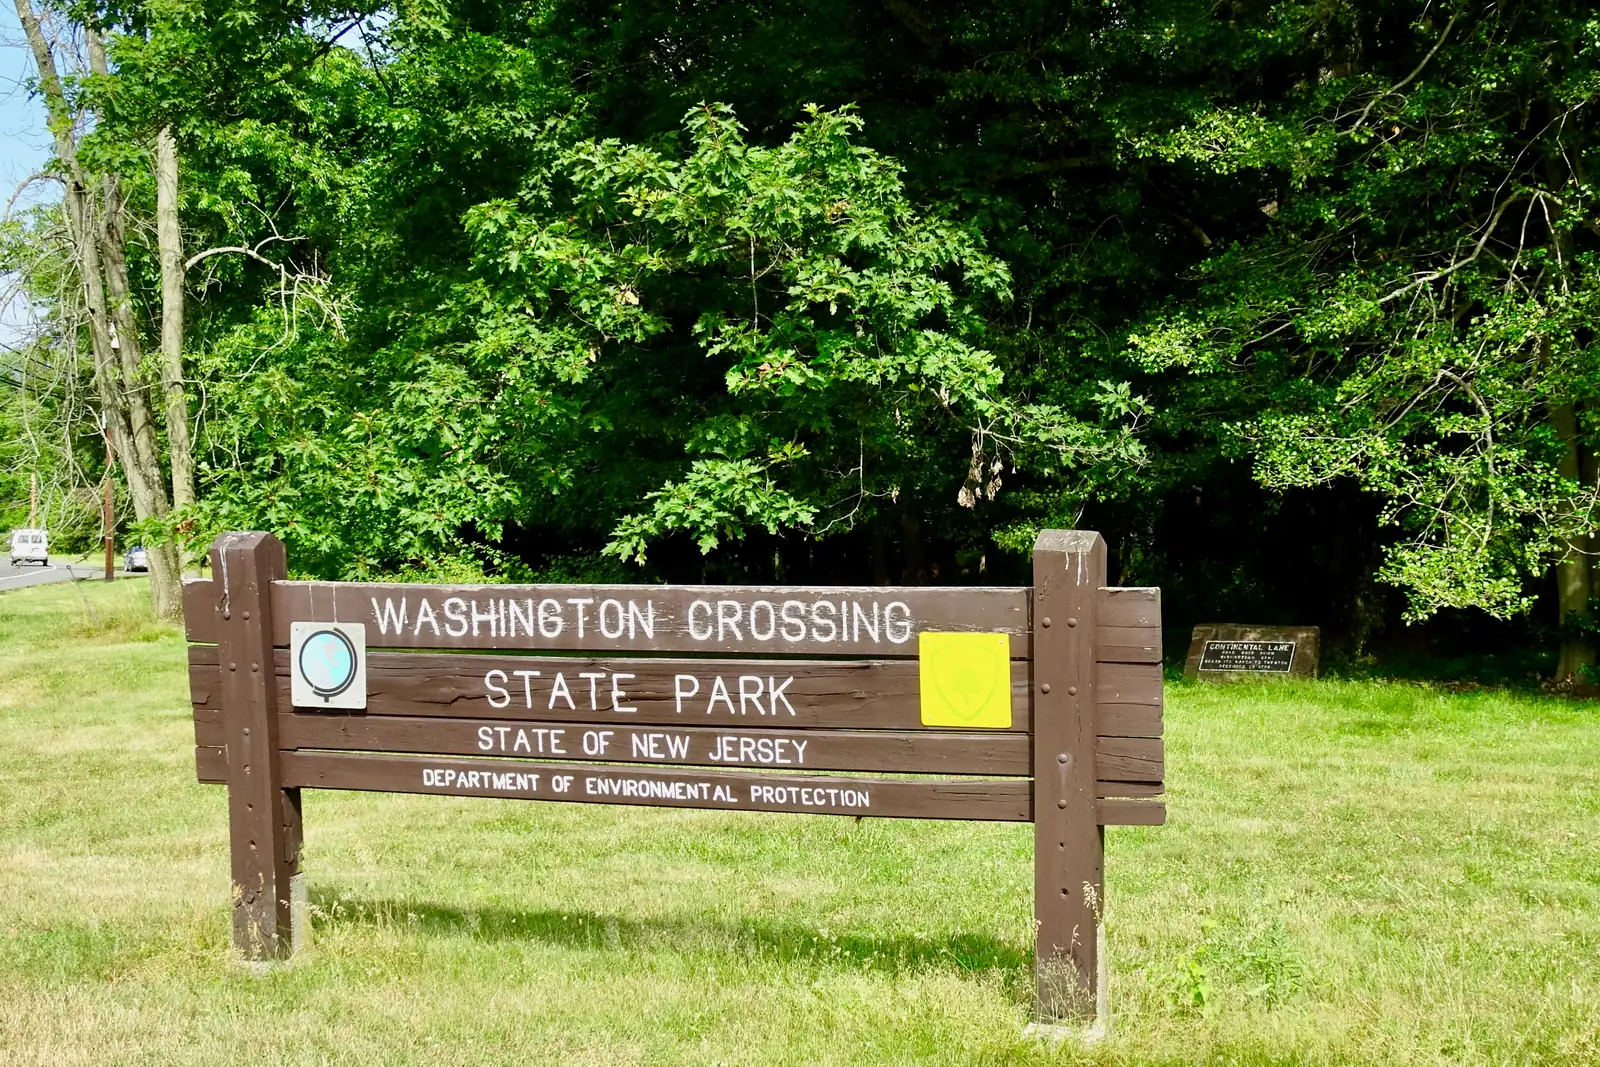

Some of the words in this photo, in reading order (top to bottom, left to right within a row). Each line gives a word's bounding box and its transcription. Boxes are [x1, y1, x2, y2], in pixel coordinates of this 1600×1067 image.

[371, 597, 655, 640] WASHINGTON
[687, 599, 912, 644] CROSSING
[1209, 643, 1263, 651] CONTINENTAL
[484, 669, 638, 713] STATE
[674, 674, 796, 717] PARK
[477, 726, 567, 754] STATE
[582, 730, 615, 756] OF
[631, 732, 690, 760] NEW
[708, 735, 808, 764] JERSEY
[422, 768, 541, 792] DEPARTMENT
[551, 774, 575, 793] OF
[585, 777, 738, 803] ENVIRONMENTAL
[750, 785, 870, 808] PROTECTION
